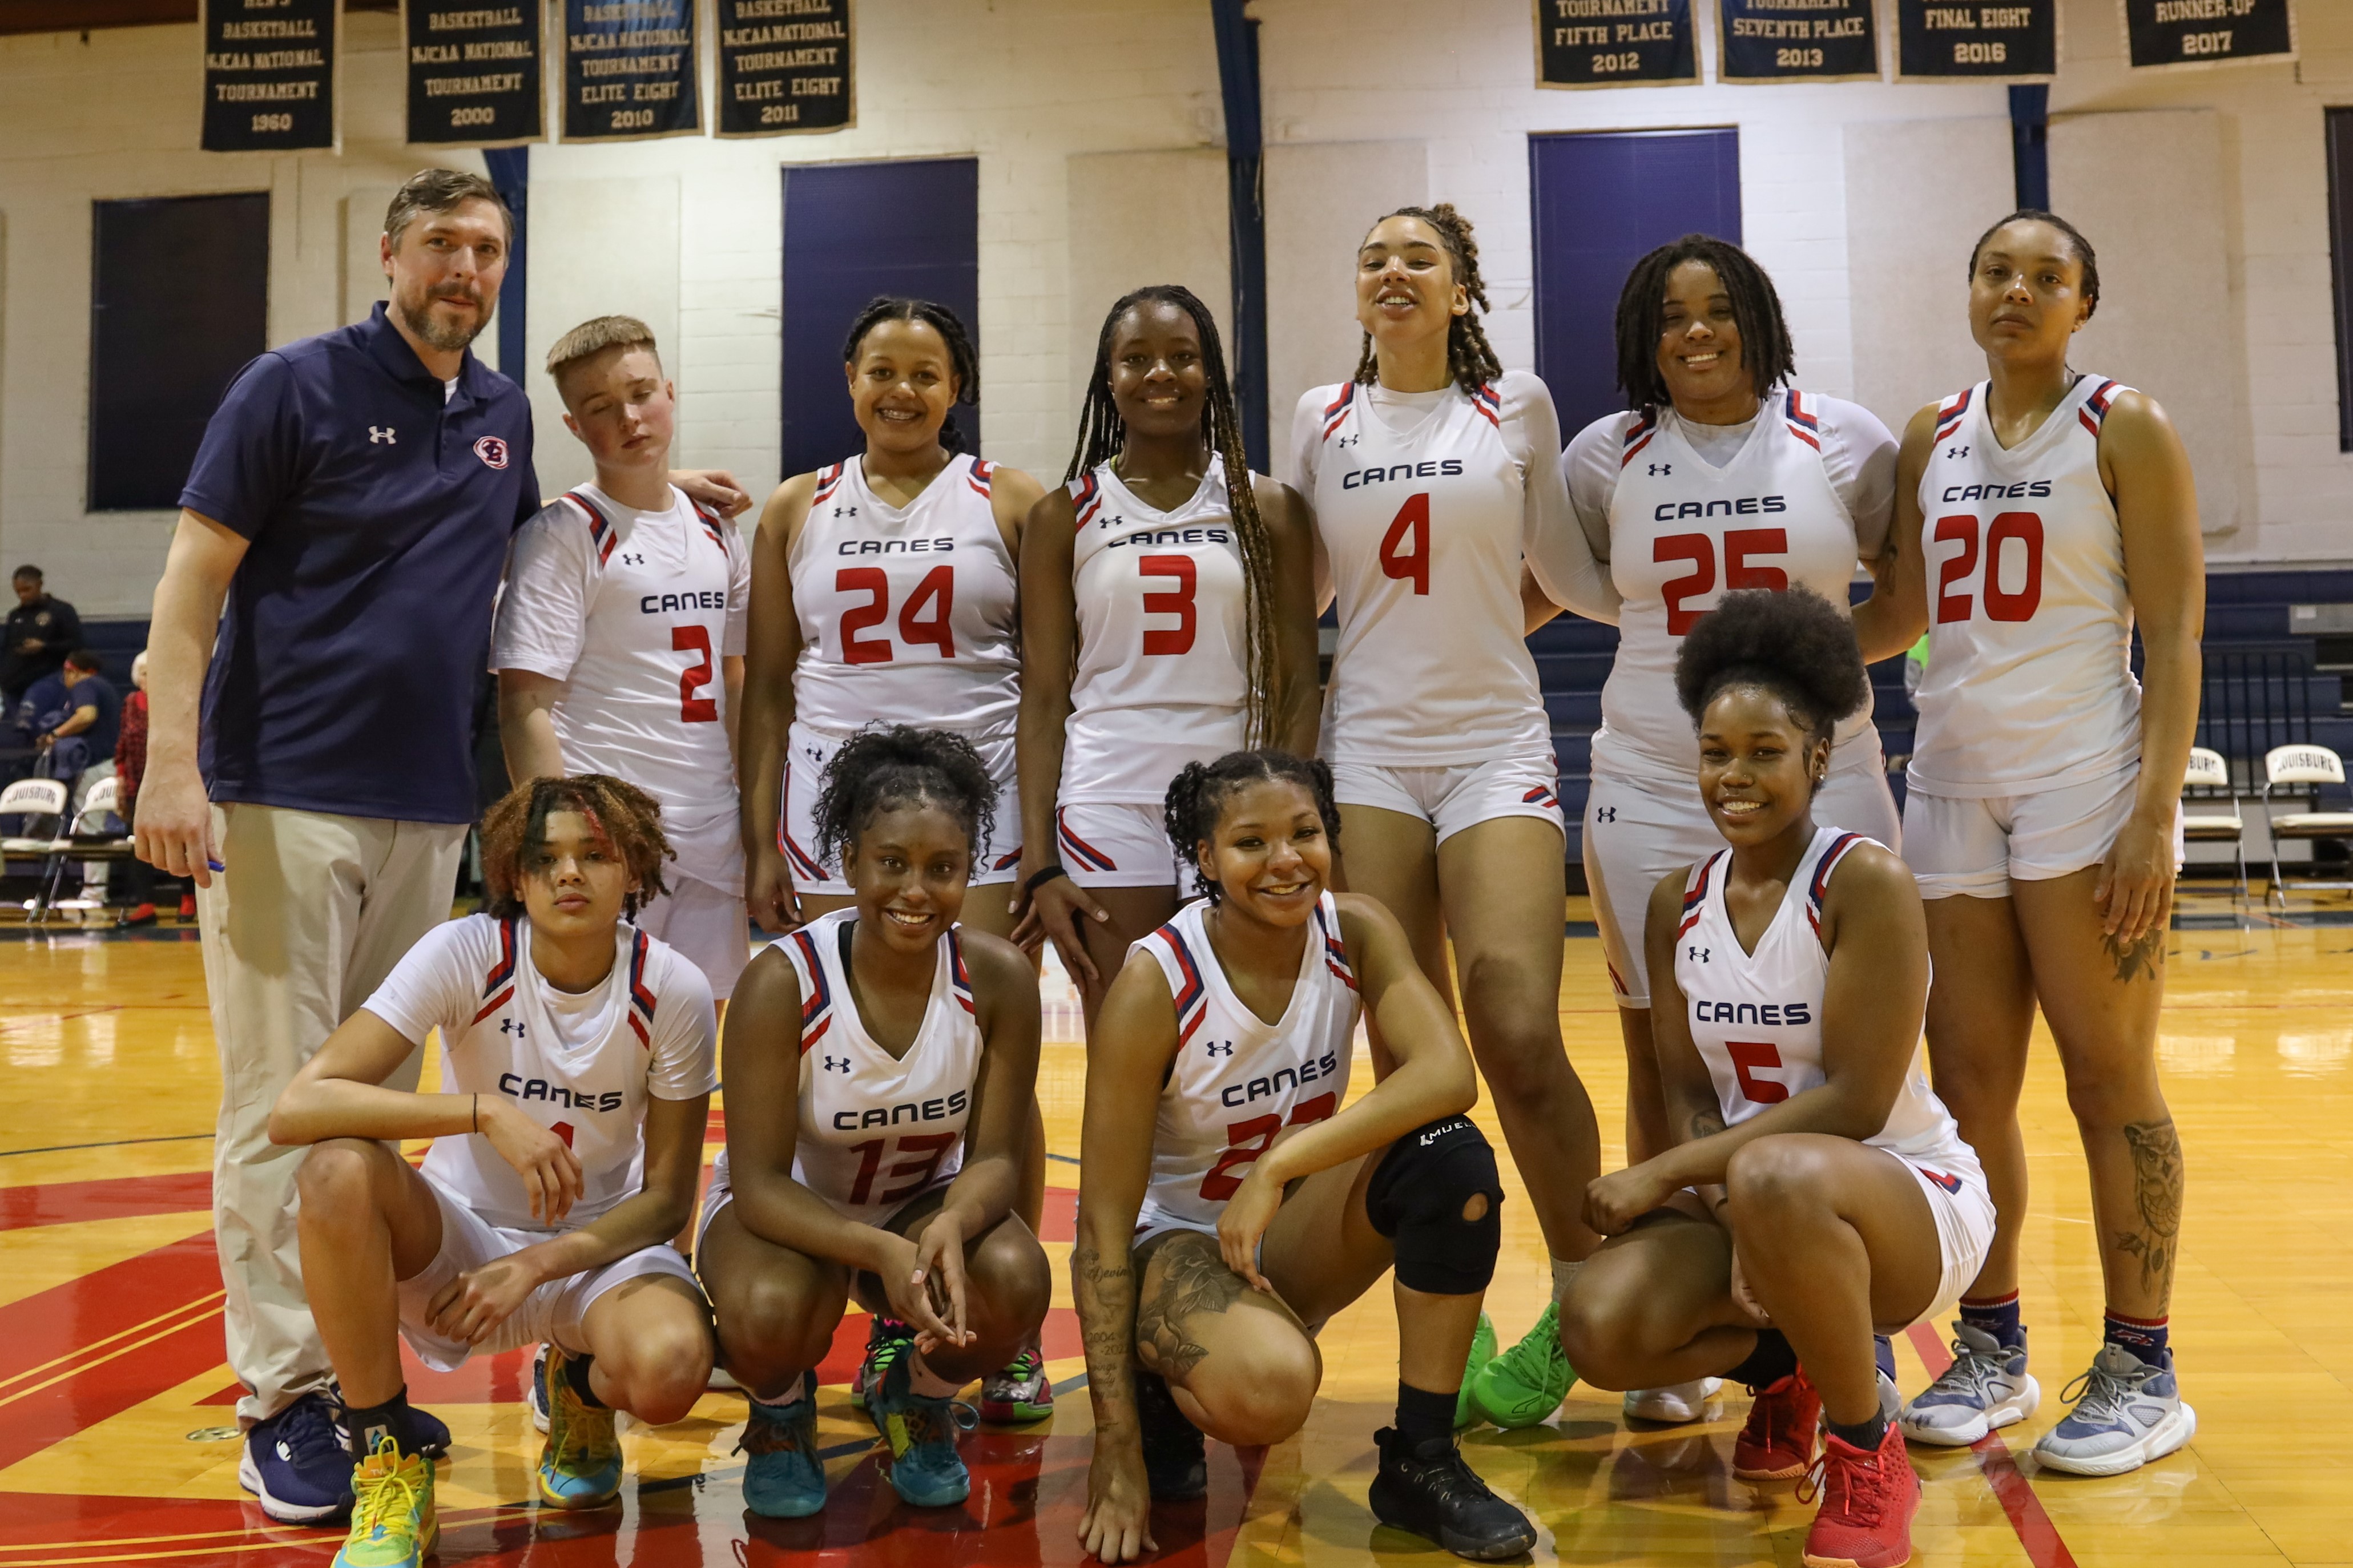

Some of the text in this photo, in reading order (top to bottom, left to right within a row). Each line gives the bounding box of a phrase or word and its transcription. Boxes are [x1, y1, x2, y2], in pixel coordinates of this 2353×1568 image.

[429, 7, 523, 31] BASKETBALL
[583, 0, 678, 23] BASKETBALL
[735, 0, 832, 19] BASKETBALL
[1556, 0, 1669, 18] TOURNAMENT
[1924, 7, 2032, 29] FINAL EIGHT
[2155, 0, 2255, 23] RUNNER-UP
[223, 19, 317, 39] BASKETBALL
[619, 29, 691, 48] NATIONAL
[772, 20, 846, 42] NATIONAL
[1554, 21, 1673, 46] FIFTH PLACE
[1733, 17, 1865, 39] SEVENTH PLACE
[464, 39, 534, 61] NATIONAL
[1953, 42, 2007, 63] 2016
[2182, 31, 2234, 55] 2017
[253, 48, 325, 70] NATIONAL
[581, 53, 680, 77] TOURNAMENT
[735, 47, 838, 73] TOURNAMENT
[1592, 51, 1640, 73] 2012
[1776, 48, 1823, 67] 2013
[216, 81, 319, 102] TOURNAMENT
[424, 72, 523, 97] TOURNAMENT
[582, 81, 679, 104] ELITE EIGHT
[735, 77, 841, 101] ELITE EIGHT
[252, 114, 292, 132] 1960
[450, 107, 495, 126] 2000
[611, 109, 654, 128] 2010
[761, 104, 799, 124] 2011
[1343, 459, 1463, 490] CANES
[1943, 479, 2052, 502] CANES
[1655, 495, 1787, 521] CANES
[838, 537, 954, 555] CANES
[1379, 492, 1430, 595] 4
[1934, 511, 2044, 624] 20
[1653, 528, 1788, 636] 25
[640, 591, 724, 614] CANES
[1139, 555, 1196, 656] 3
[836, 565, 956, 665] 24
[672, 625, 718, 722] 2
[1697, 1001, 1811, 1026] CANES
[1222, 1050, 1337, 1107] CANES
[1725, 1041, 1789, 1104] 5
[498, 1073, 623, 1112] CANES
[833, 1089, 966, 1130] CANES
[847, 1131, 956, 1205] 13
